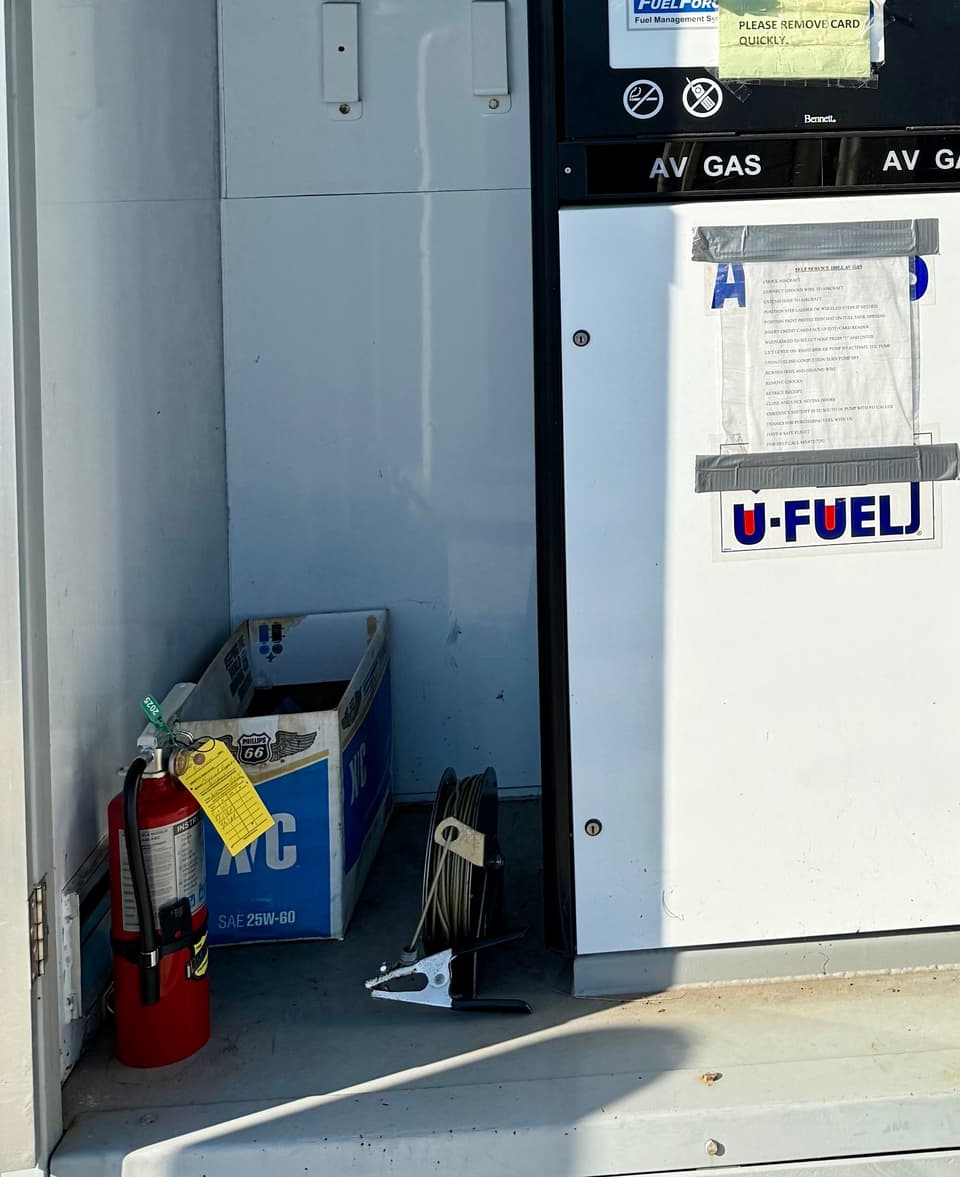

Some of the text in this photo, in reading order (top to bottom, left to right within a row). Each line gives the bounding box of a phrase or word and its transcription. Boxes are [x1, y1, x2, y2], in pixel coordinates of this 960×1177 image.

[634, 16, 652, 24] Fuel
[653, 14, 705, 25] Management
[738, 18, 861, 30] PLEASE REMOVE CARD
[738, 36, 790, 47] QUICKLY.
[649, 154, 762, 179] AV GAS
[882, 150, 920, 172] AV
[144, 696, 160, 716] 2025
[242, 738, 266, 746] PHILLIPS
[244, 746, 264, 759] 66
[218, 910, 296, 928] SAE 25W-60
